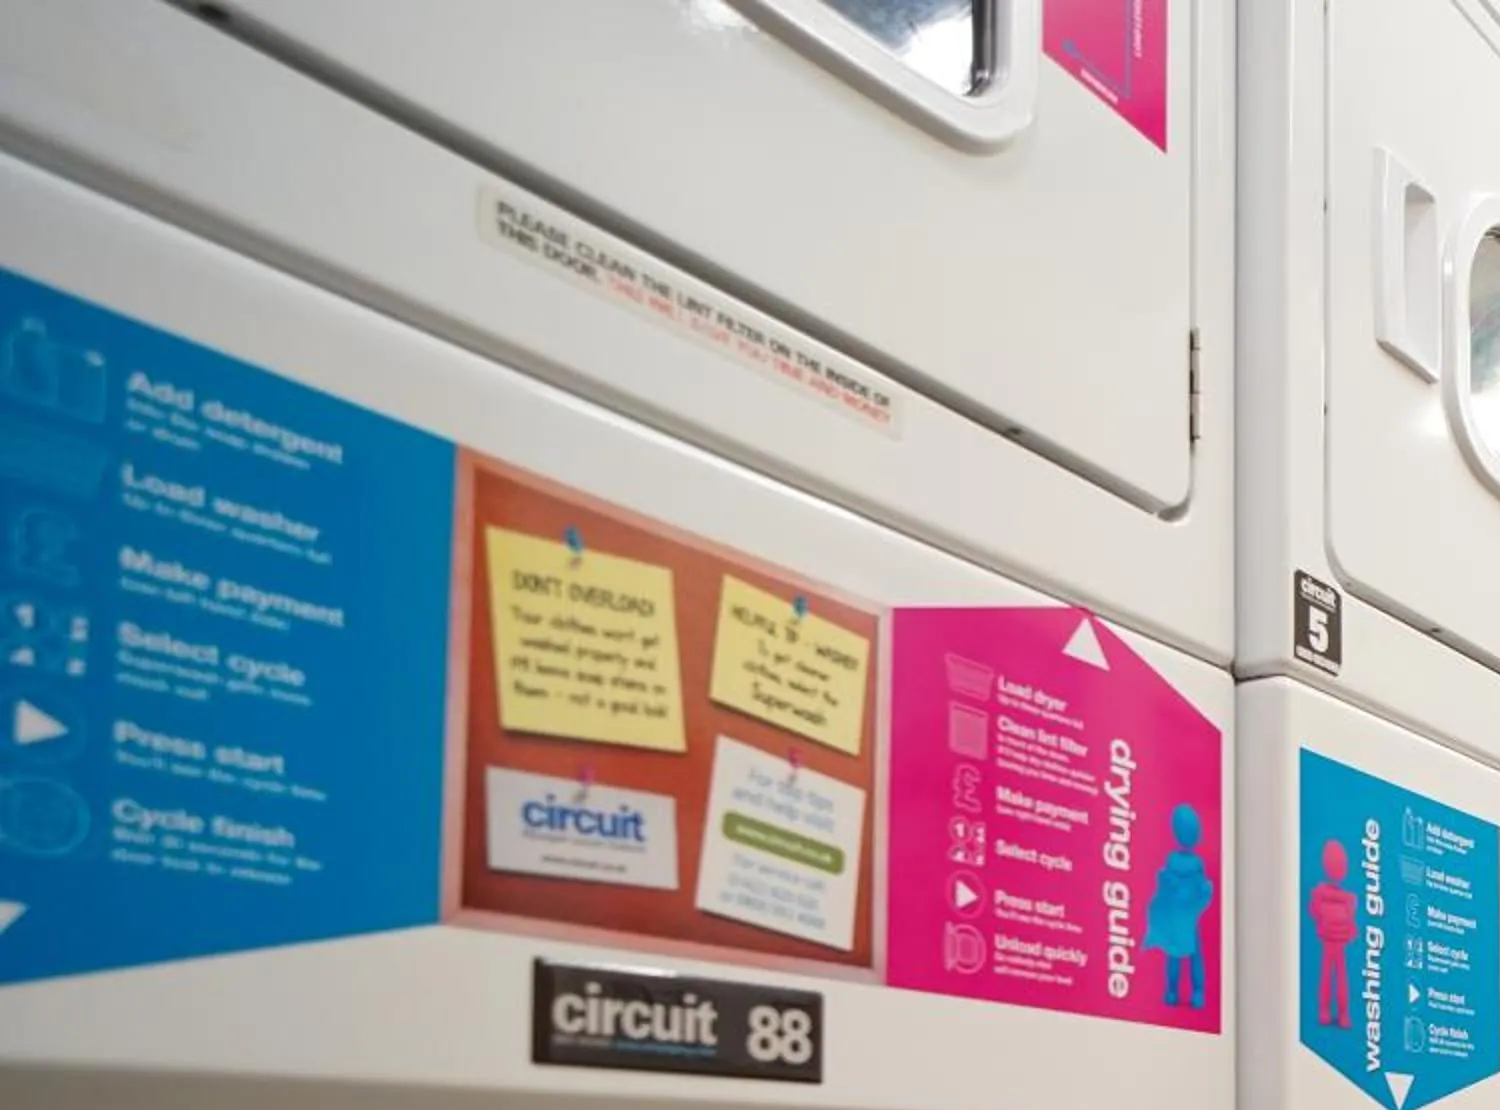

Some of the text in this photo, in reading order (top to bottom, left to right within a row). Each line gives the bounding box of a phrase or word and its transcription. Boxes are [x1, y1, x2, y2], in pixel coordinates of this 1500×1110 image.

[497, 218, 540, 252] THIS
[496, 200, 569, 249] PLEASE
[575, 239, 636, 283] CLEAN
[641, 271, 673, 300] THE
[677, 290, 713, 320] LINT
[715, 310, 766, 346] FILTER
[769, 337, 791, 360] ON
[796, 350, 823, 376] THE
[825, 366, 871, 399] INSIDE
[128, 372, 194, 411] Add
[200, 400, 343, 464] detergent
[122, 463, 320, 541] Load washer
[118, 546, 210, 590] Make
[215, 577, 344, 627] payment
[117, 620, 219, 665] Select
[226, 653, 307, 687] cycle
[1308, 604, 1329, 653] 5
[998, 674, 1032, 700] Load
[1033, 688, 1068, 713] dryer
[113, 720, 285, 776] Press start
[997, 714, 1036, 739] Clean
[1038, 728, 1059, 747] lint
[1060, 735, 1088, 758] filter
[111, 798, 295, 848] Cycle finish
[521, 793, 645, 842] circuit
[996, 785, 1033, 809] Make
[1035, 799, 1089, 825] payment
[996, 840, 1073, 872] Select cycle
[1103, 738, 1137, 999] drying guide
[994, 889, 1065, 919] Press start
[994, 934, 1088, 968] Unload quickly
[1361, 819, 1384, 1072] washing guide
[553, 982, 813, 1064] circuit 88
